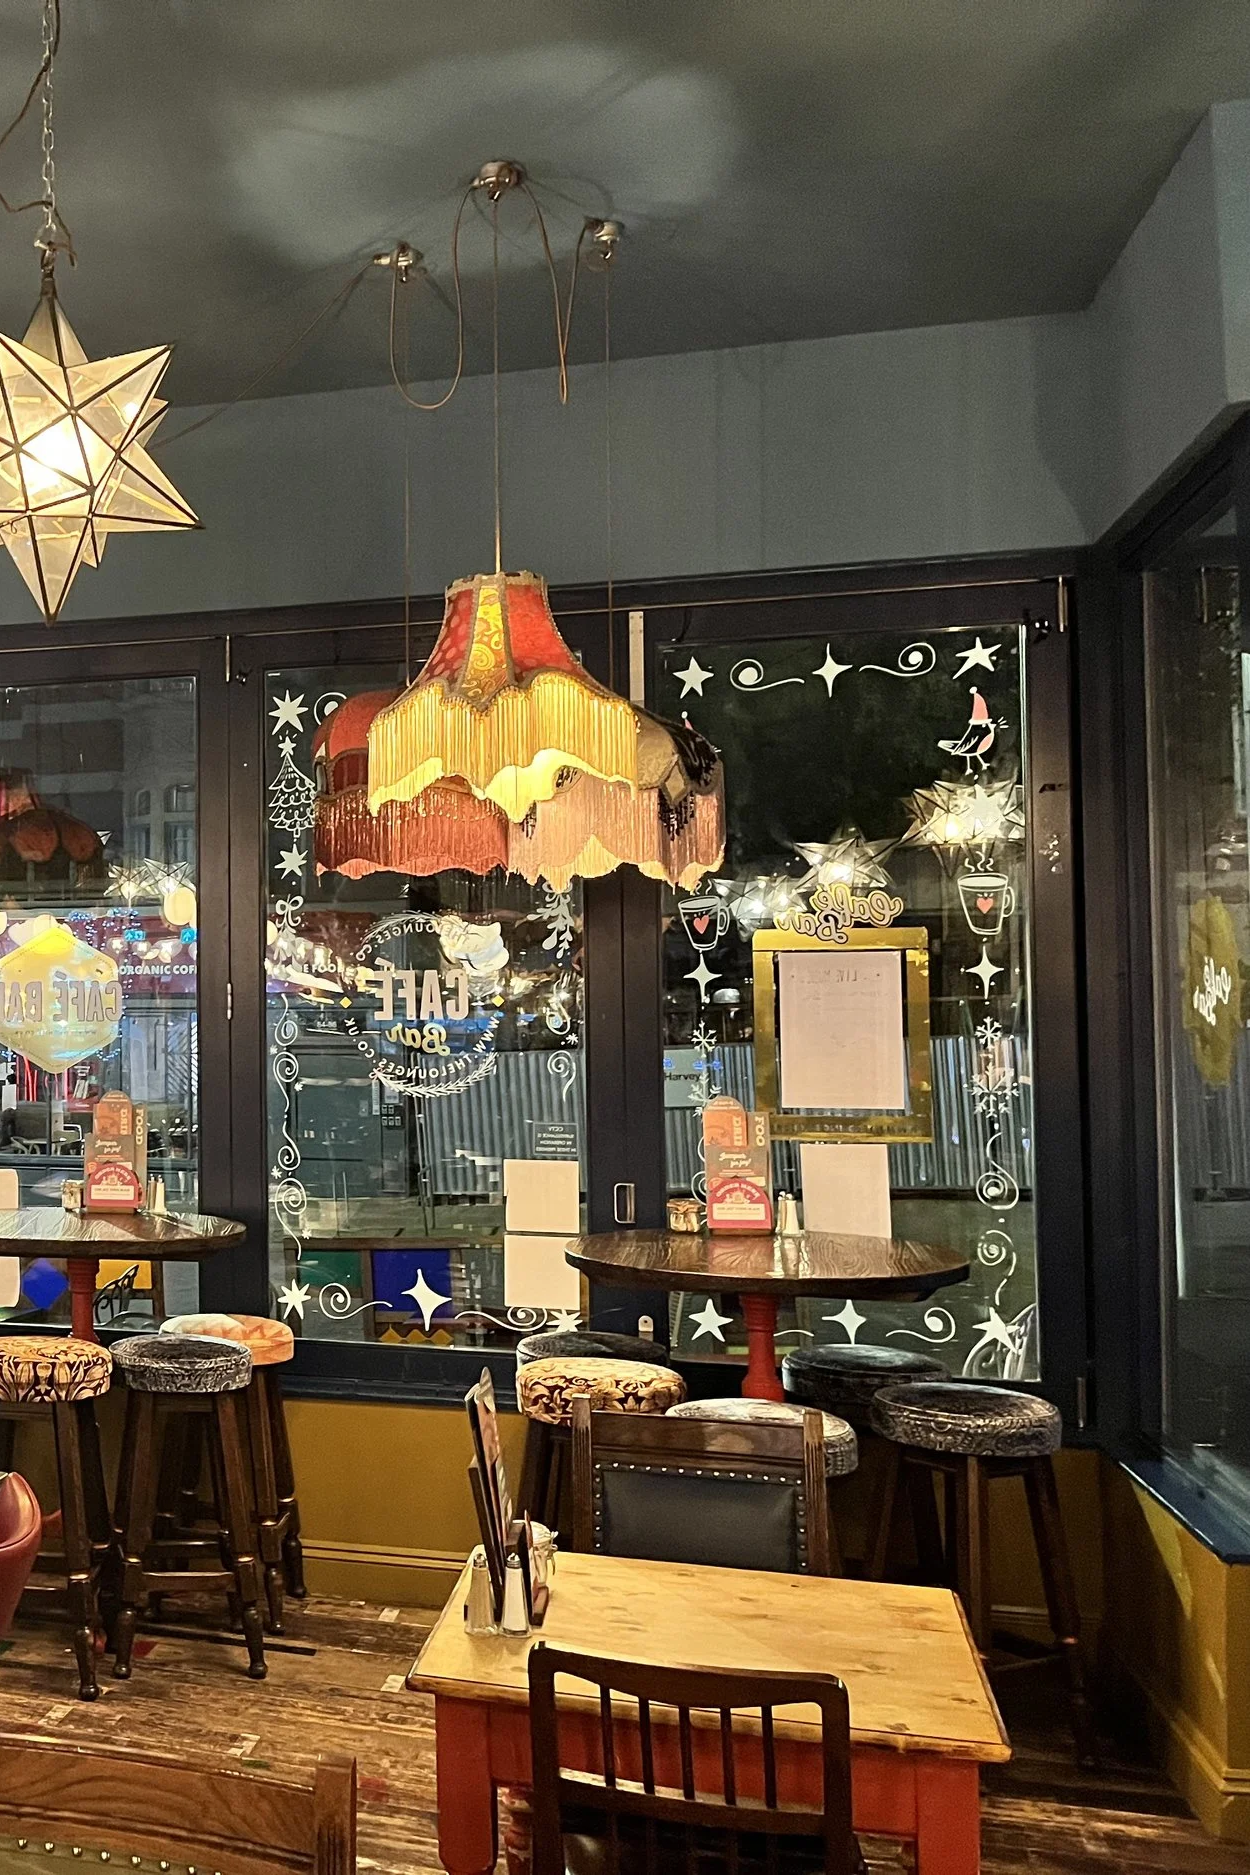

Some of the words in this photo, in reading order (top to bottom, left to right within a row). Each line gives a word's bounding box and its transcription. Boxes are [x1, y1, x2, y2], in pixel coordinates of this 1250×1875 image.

[119, 965, 170, 975] ORGANIC
[136, 1108, 144, 1145] FOOD
[754, 1115, 765, 1147] FOO
